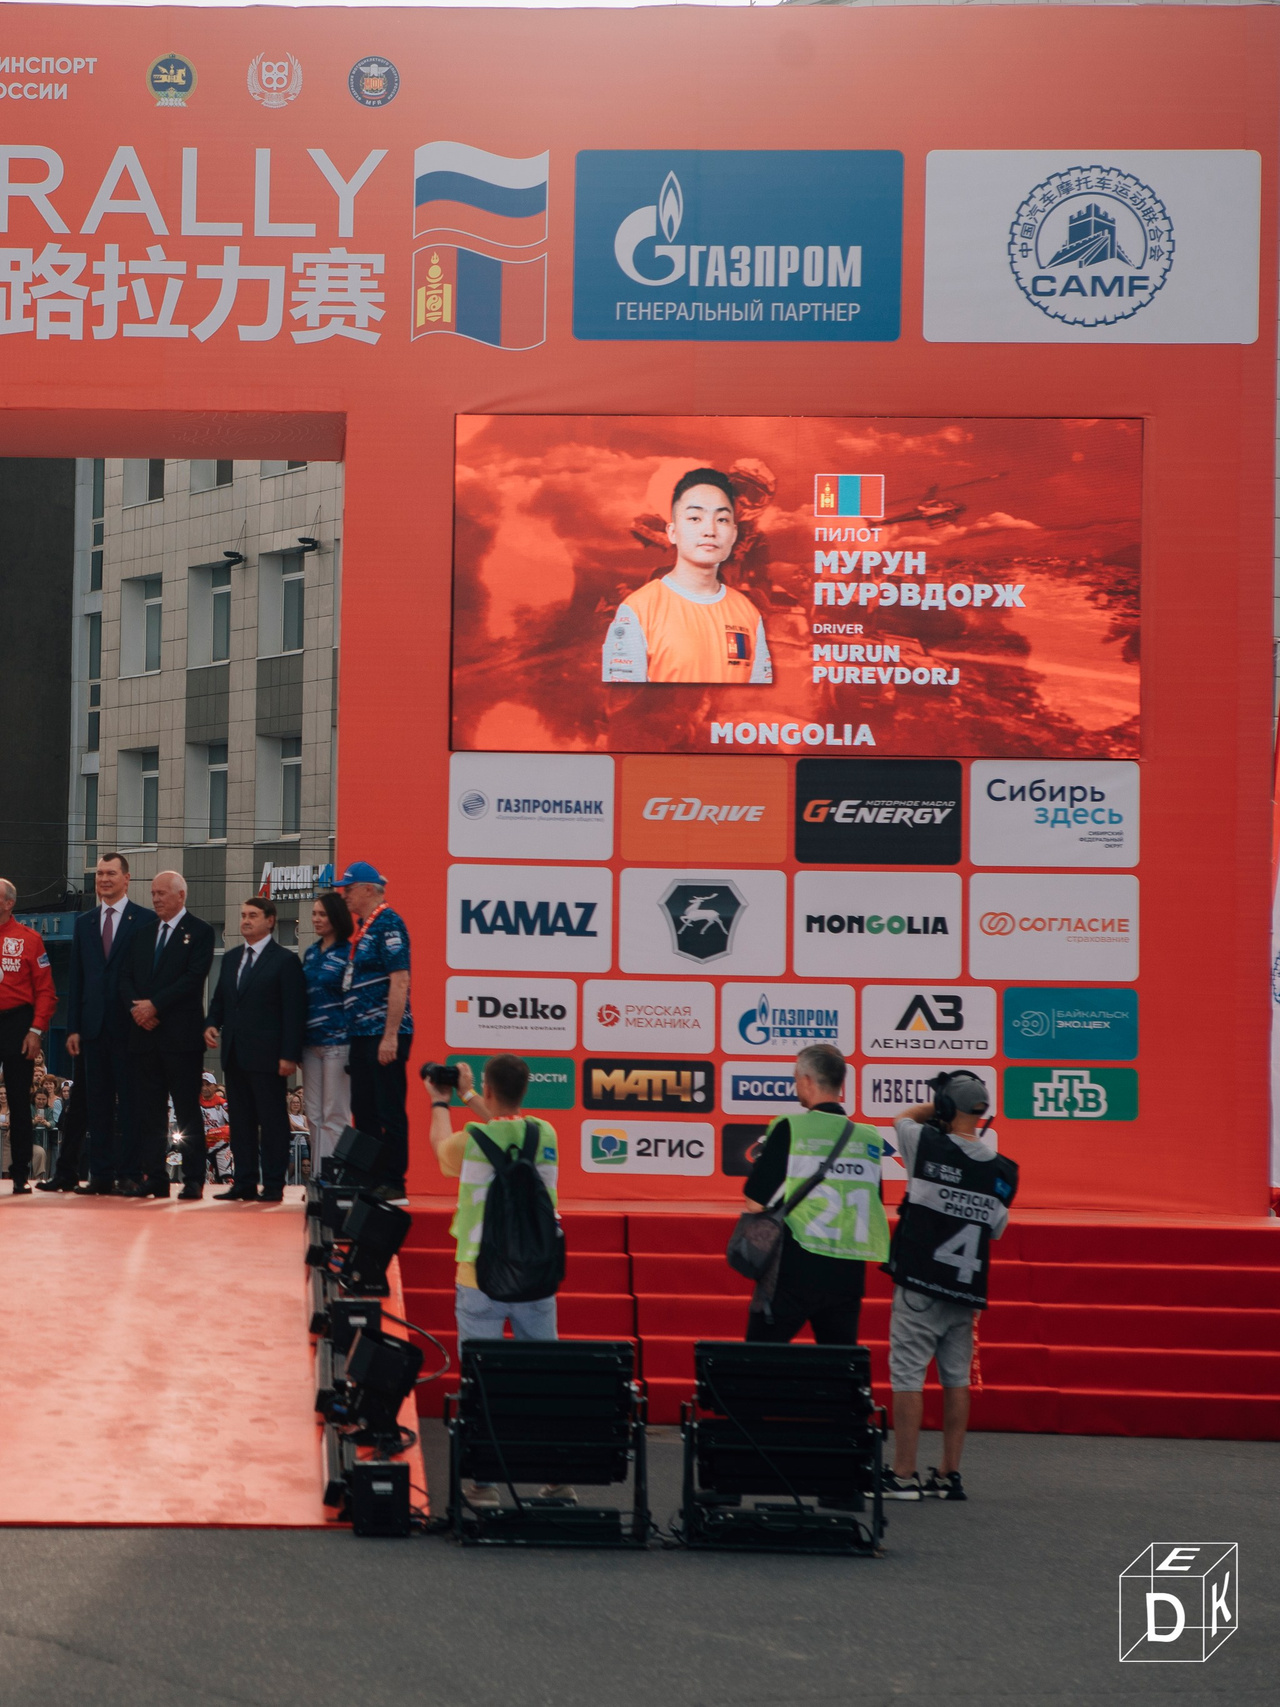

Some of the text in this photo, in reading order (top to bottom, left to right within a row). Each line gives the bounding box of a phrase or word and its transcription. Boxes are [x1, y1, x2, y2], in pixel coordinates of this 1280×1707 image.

[1018, 175, 1165, 262] 中国汽车摩托车运动联合会
[689, 245, 862, 288] ГАЗПРОМ
[1031, 275, 1150, 298] CAMF
[616, 299, 862, 322] ГЕНЕРАЛЬНЫЙ ПАРТНЕР
[814, 528, 883, 542] ПИЛОТ
[814, 551, 927, 575] МУРУН
[813, 582, 1027, 611] ПУРЭВДОРЖ
[813, 624, 863, 634] DRIVER
[812, 644, 900, 663] MURUN
[812, 666, 960, 686] PUREVDORJ
[710, 722, 876, 746] MONGOLIA
[986, 778, 1106, 808] Сибирь
[497, 799, 604, 815] ГАЗПРОМБАНК
[1034, 807, 1124, 829] здесь
[461, 899, 598, 937] KAMAZ
[806, 914, 949, 935] MONGOLIA
[1019, 917, 1130, 933] СОГЛАСИЕ
[1066, 935, 1130, 944] страхование
[1, 957, 21, 965] SILK
[1, 964, 21, 972] WAY
[477, 996, 567, 1020] Delko
[625, 1004, 691, 1017] РУССКАЯ
[772, 1008, 838, 1026] ГАЗПРОМ
[1056, 1010, 1129, 1019] БАЙКАЛЬСК
[625, 1017, 701, 1029] МЕХАНИКА
[1056, 1020, 1111, 1029] ЭКО.ЦЕХ
[772, 1028, 838, 1038] ДОБЫЧА
[871, 1039, 989, 1050] ЛЕНЗОЛОТО
[591, 1069, 706, 1103] МАТЧ!
[739, 1080, 797, 1097] РОССИ
[872, 1079, 932, 1103] ИЗВЕСТ
[1033, 1070, 1108, 1118] НТВ
[636, 1138, 704, 1158] 2ГИС
[820, 1162, 864, 1175] OTO
[940, 1164, 962, 1176] SILK
[940, 1173, 962, 1184] WAY
[938, 1188, 995, 1211] OFFICIAL
[805, 1185, 869, 1243] 21
[943, 1202, 989, 1221] PHOTO
[933, 1223, 982, 1284] 4
